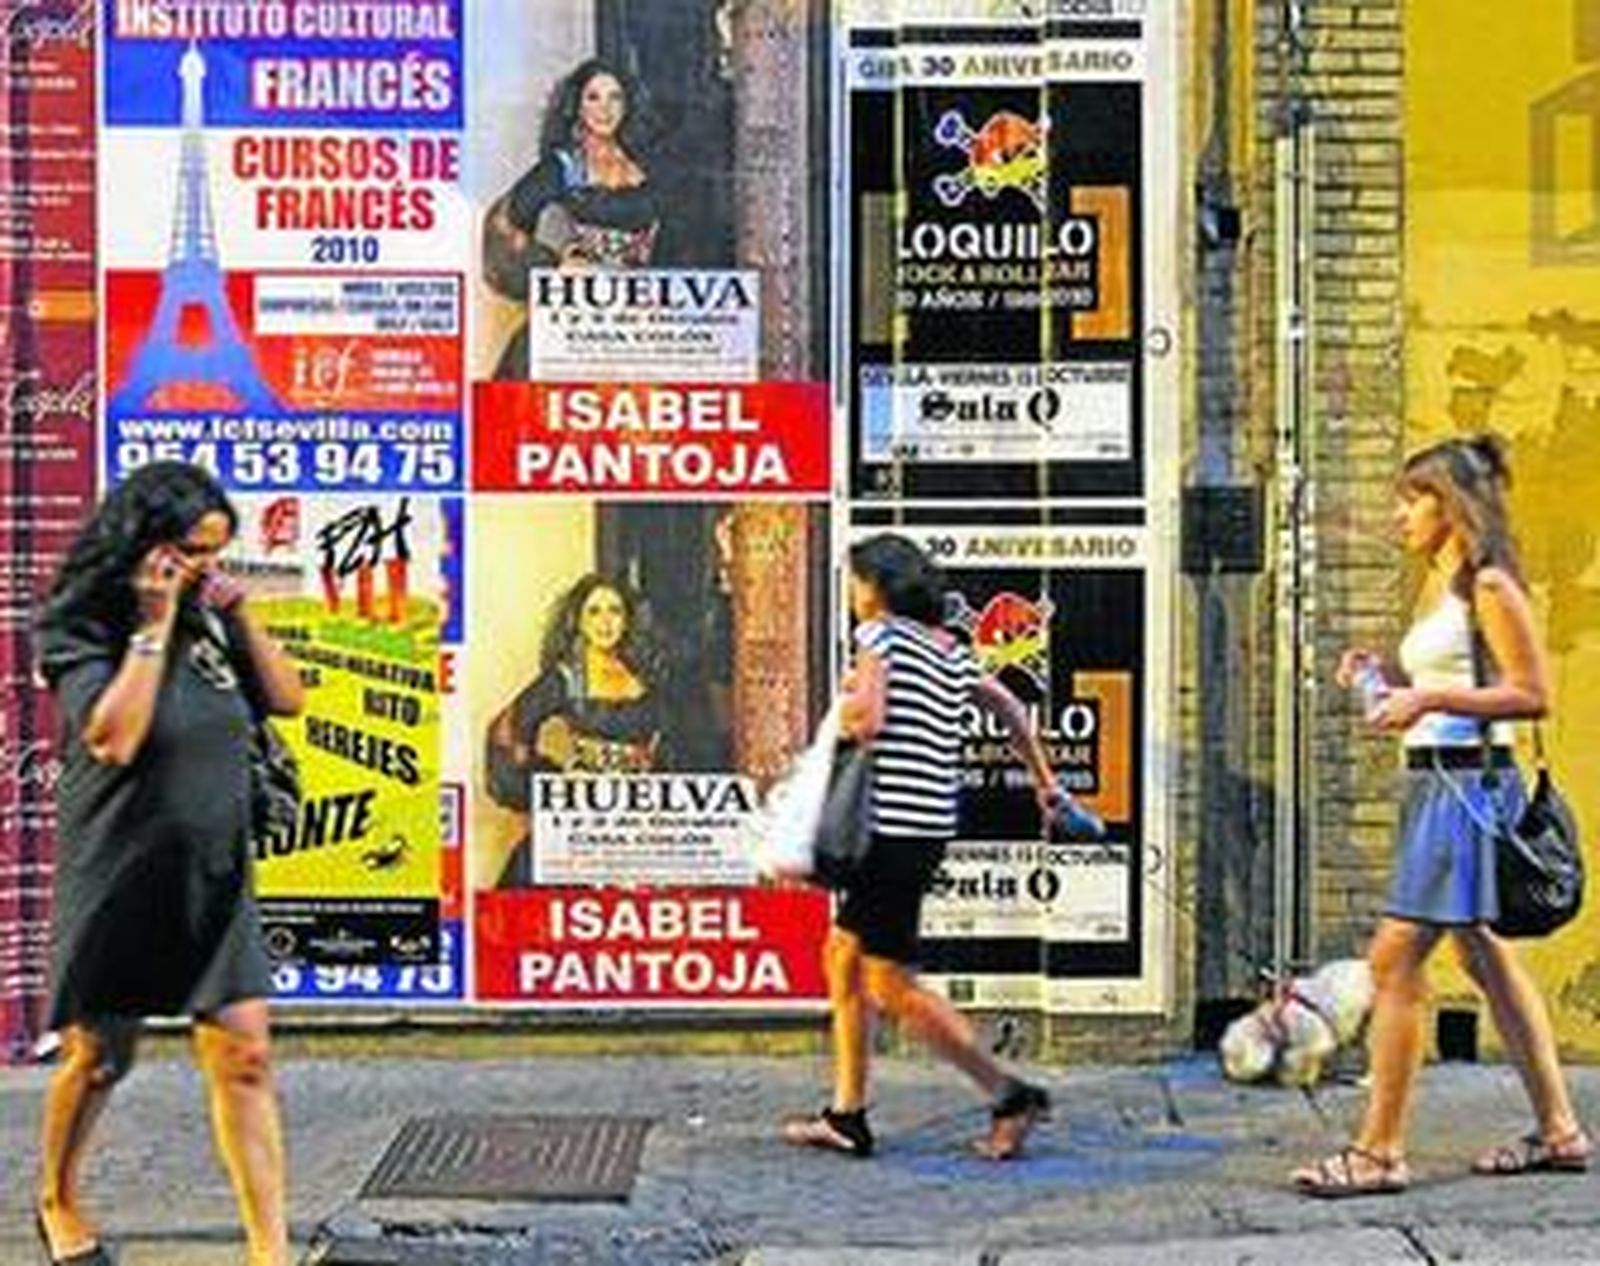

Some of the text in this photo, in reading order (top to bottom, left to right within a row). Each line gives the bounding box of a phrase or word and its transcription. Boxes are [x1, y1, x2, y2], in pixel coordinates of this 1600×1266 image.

[115, 0, 286, 39] INSTITUTO
[294, 0, 454, 39] CULTURAL
[252, 51, 452, 111] FRANCÉS
[921, 55, 956, 77] 30
[232, 136, 460, 181] CURSOS DE
[255, 180, 436, 231] FRANCÉS
[310, 235, 379, 264] 2010
[537, 276, 753, 308] HUELVA
[547, 390, 760, 431] ISABEL
[232, 443, 301, 484] 53
[314, 443, 382, 484] 94
[395, 443, 454, 484] 75
[516, 443, 791, 485] PANTOJA
[539, 777, 753, 813] HUELVA
[549, 898, 760, 941] ISABEL
[518, 951, 791, 993] PANTOJA
